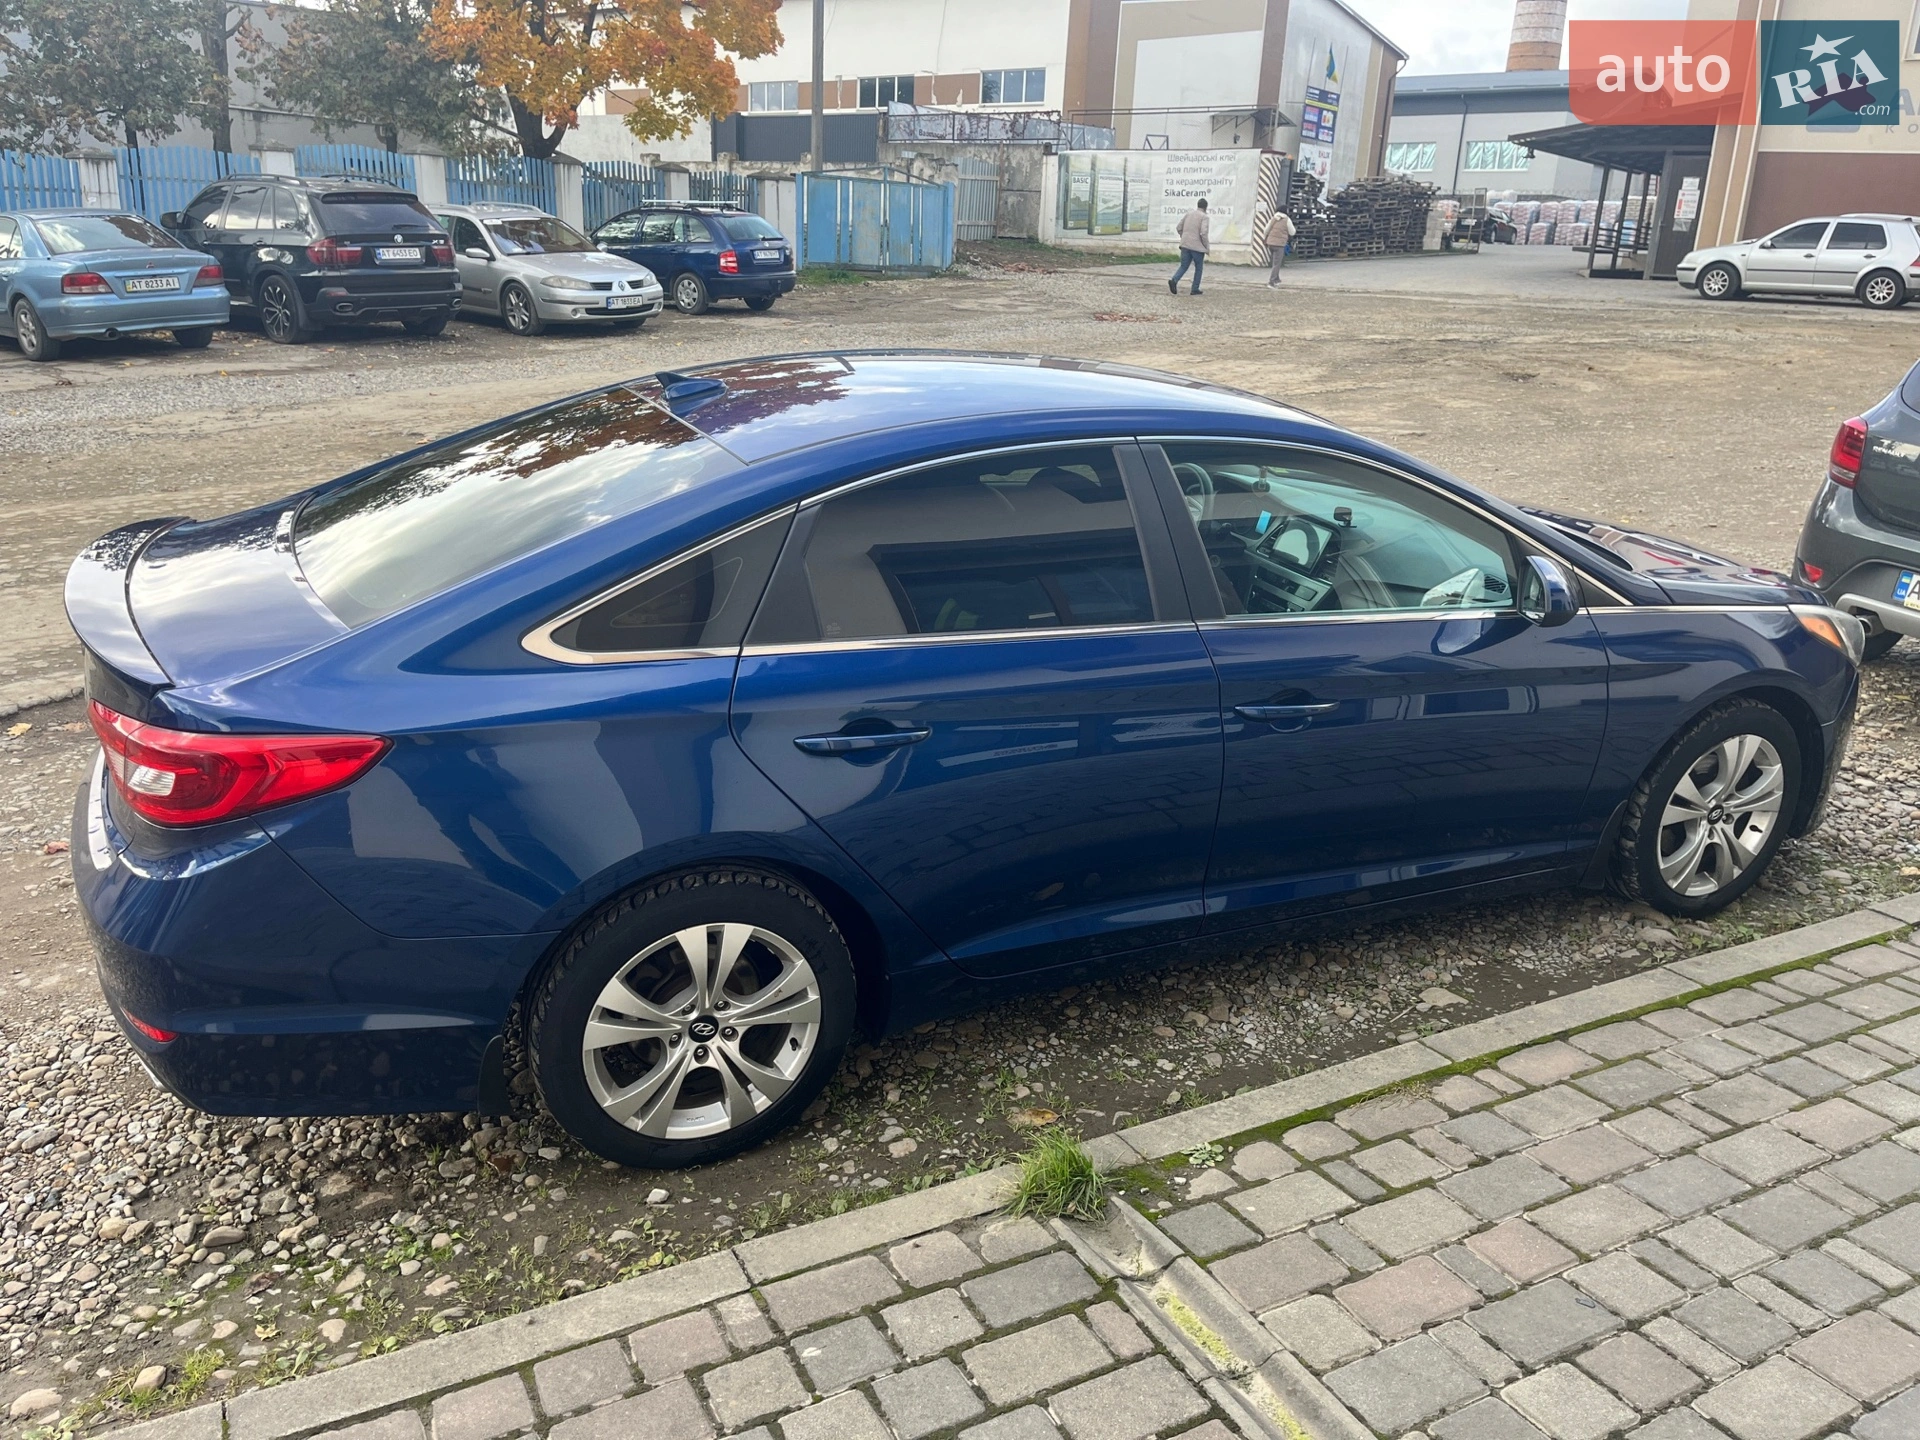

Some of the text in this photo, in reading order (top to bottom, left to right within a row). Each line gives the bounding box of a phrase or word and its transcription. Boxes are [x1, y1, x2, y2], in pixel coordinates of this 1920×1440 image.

[1167, 153, 1218, 163] Швейцарські
[1072, 176, 1090, 185] BASIC
[1176, 178, 1234, 187] керамограніту
[382, 249, 391, 258] AT
[132, 281, 142, 289] AT
[145, 279, 164, 288] 8233
[1897, 588, 1906, 596] UA
